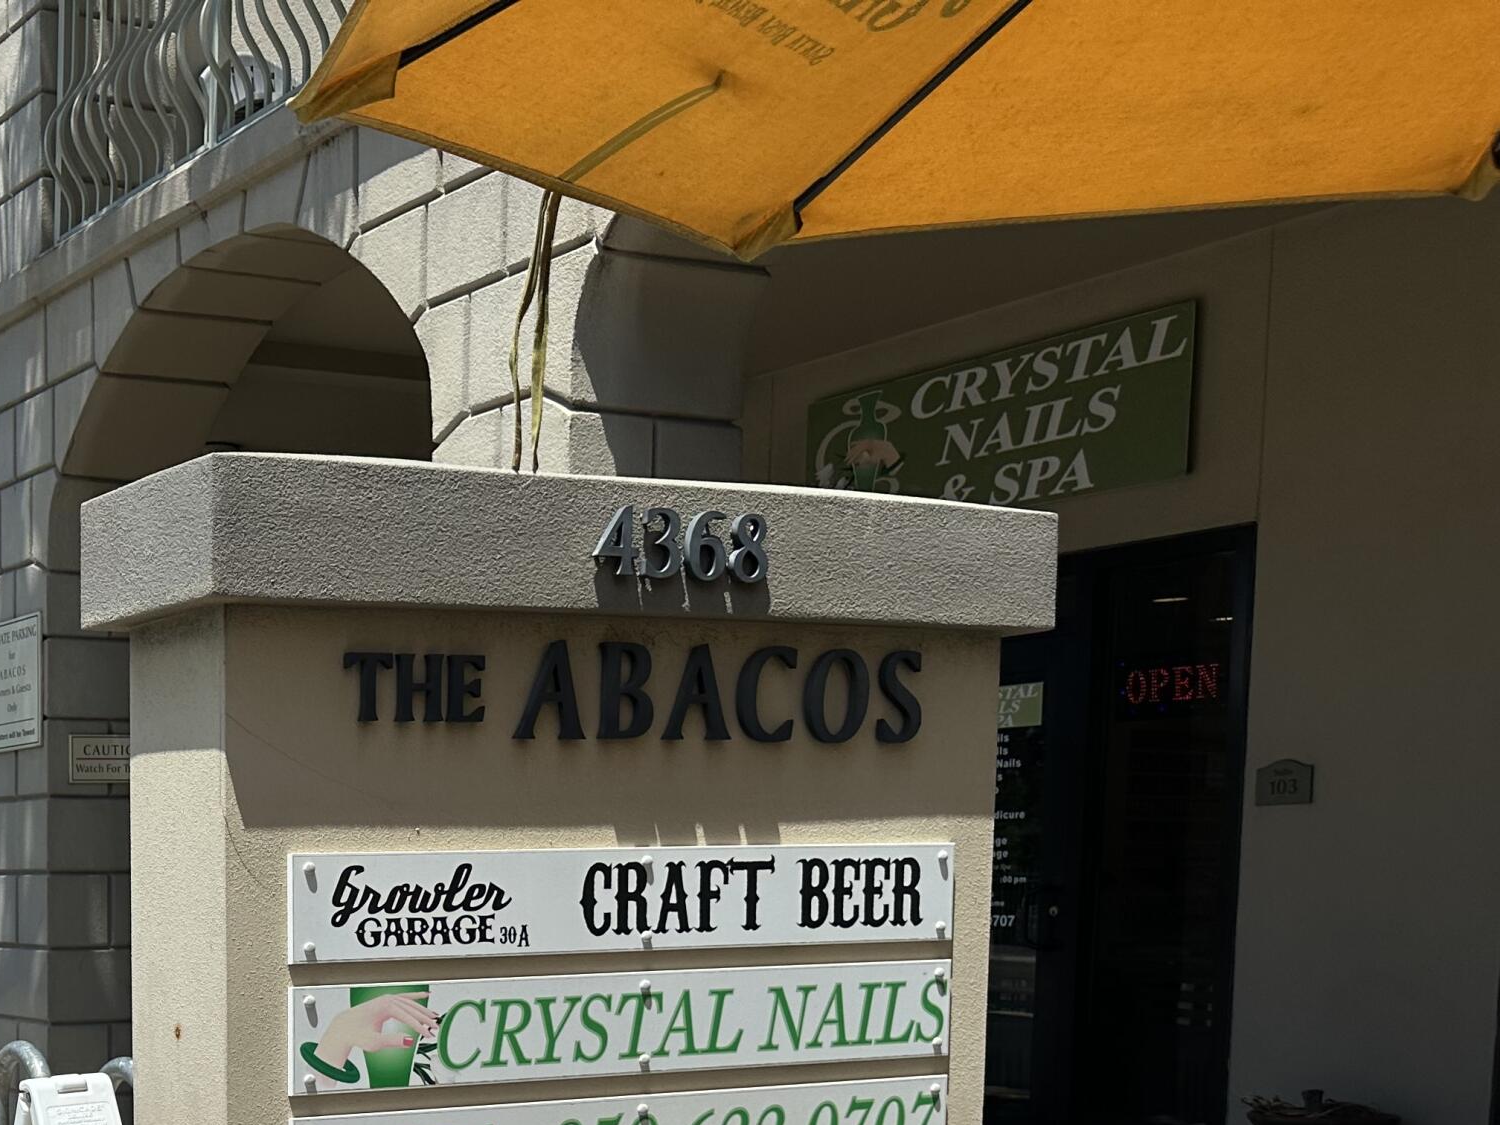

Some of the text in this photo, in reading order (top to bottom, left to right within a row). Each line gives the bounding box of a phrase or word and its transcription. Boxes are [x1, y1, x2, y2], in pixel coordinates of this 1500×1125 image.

[910, 314, 1189, 420] CRYSTAL
[935, 385, 1122, 467] NAILS
[939, 448, 1095, 506] & SPA
[593, 504, 770, 585] 4368
[11, 624, 37, 644] PARKING
[0, 665, 27, 680] ABACOS
[342, 639, 923, 744] THE ABACOS
[1126, 663, 1219, 704] OPEN
[76, 763, 104, 774] Watch
[106, 763, 121, 774] For
[1269, 778, 1298, 795] 103
[331, 863, 513, 928] Growler
[579, 854, 924, 937] CRAFT BEER
[354, 914, 531, 948] GARAGE 30A
[436, 977, 949, 1071] CRYSTAL NAILS
